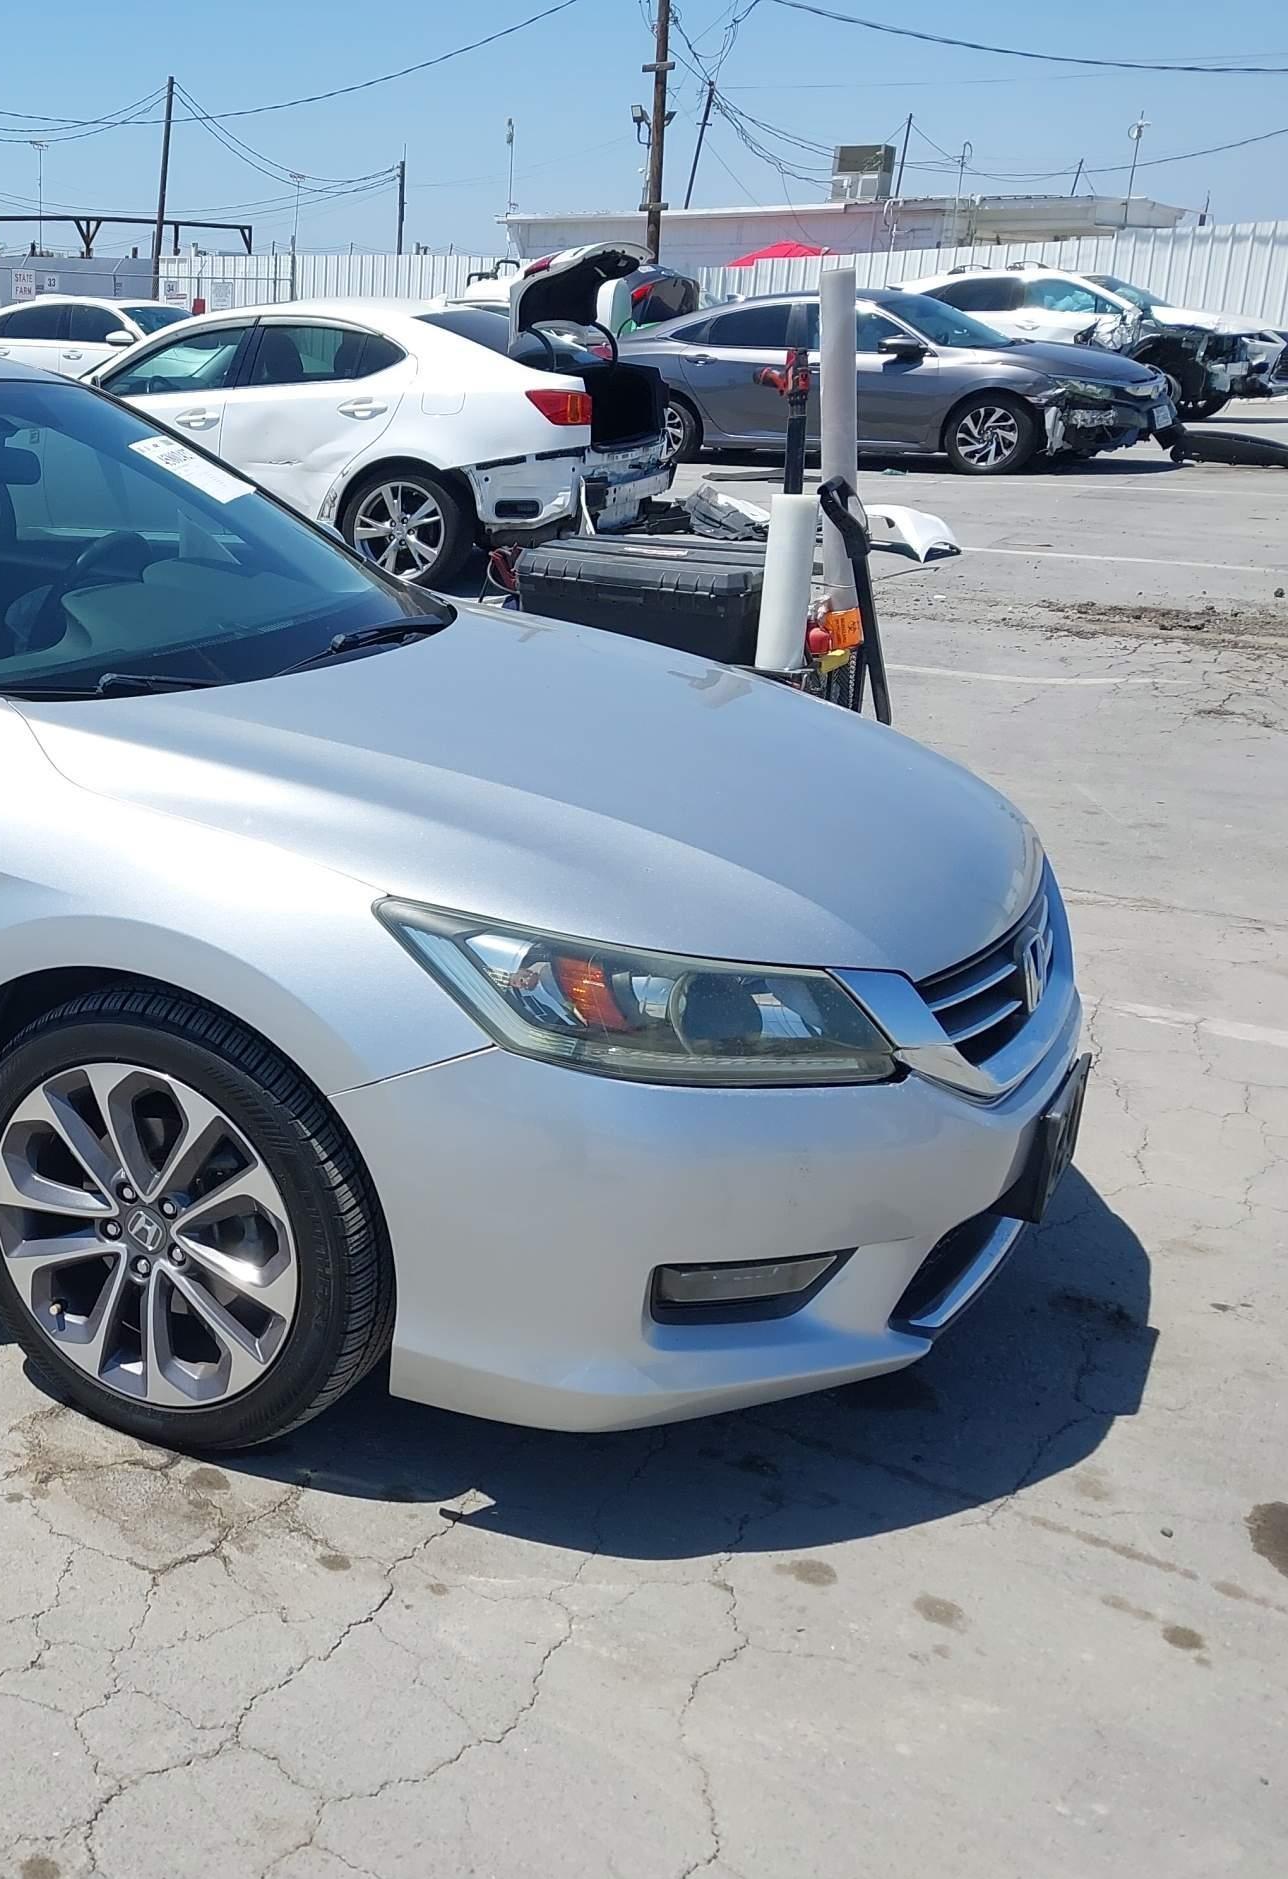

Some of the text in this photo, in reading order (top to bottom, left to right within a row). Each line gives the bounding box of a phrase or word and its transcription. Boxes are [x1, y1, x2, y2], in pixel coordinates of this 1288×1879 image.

[14, 273, 33, 283] STATE
[47, 278, 56, 287] 33
[15, 286, 32, 295] FARM
